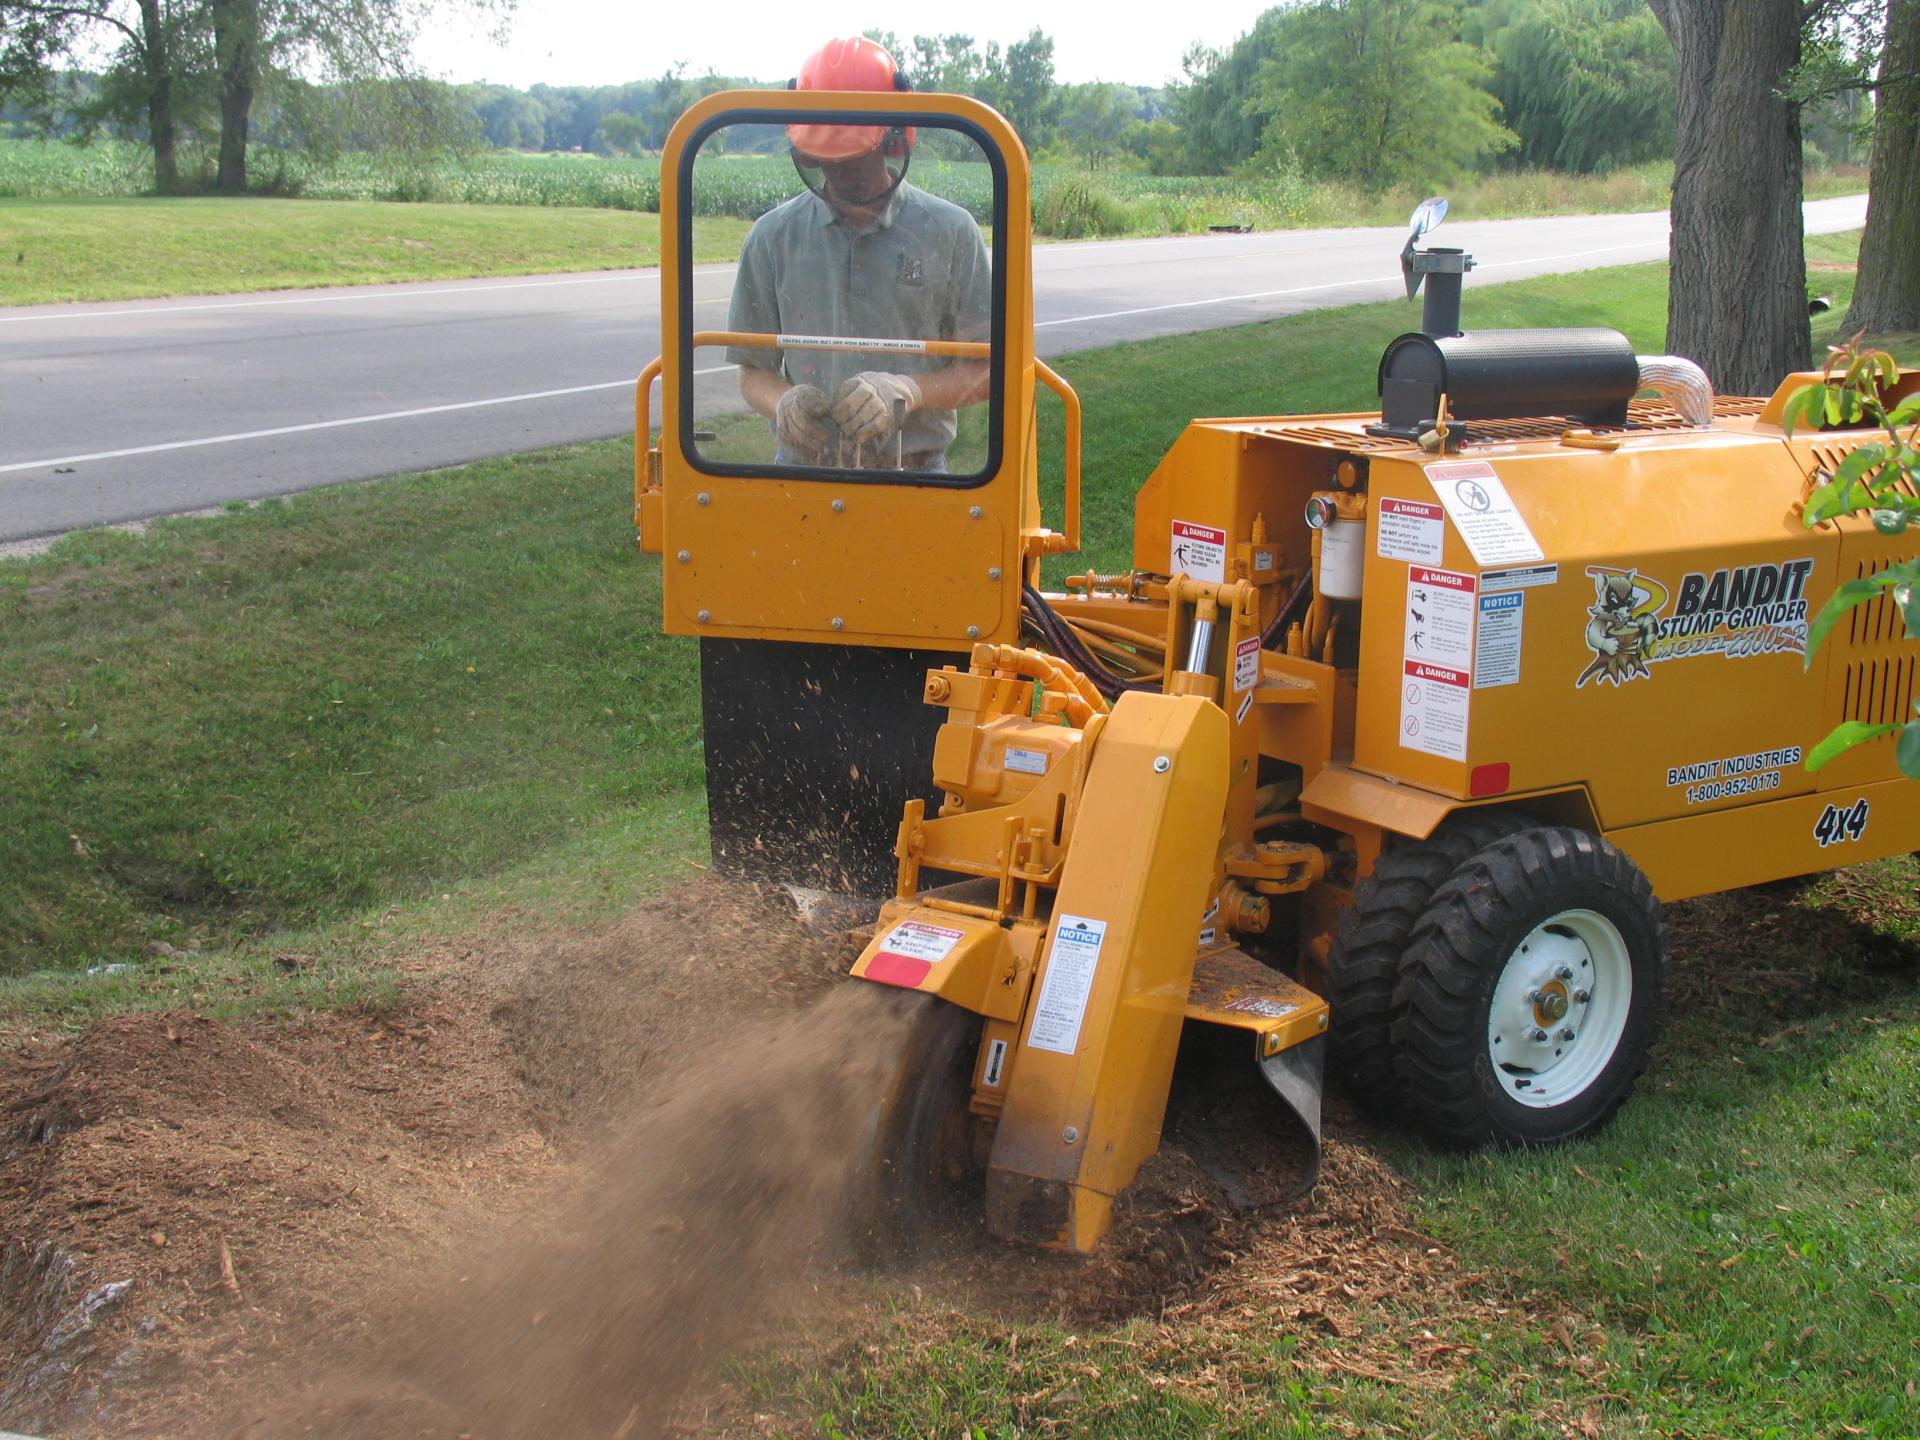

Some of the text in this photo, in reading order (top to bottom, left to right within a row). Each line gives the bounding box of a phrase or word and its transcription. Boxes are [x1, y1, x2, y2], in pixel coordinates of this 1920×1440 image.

[1401, 504, 1430, 515] DANGER
[1189, 527, 1215, 540] DANGER
[1430, 573, 1463, 586] DANGER
[1675, 560, 1813, 617] BANDIT
[1483, 595, 1518, 609] NOTICE
[1656, 600, 1807, 641] STUMP GRINDER
[1654, 634, 1728, 659] MODEL
[1425, 667, 1457, 681] DANGER
[1668, 747, 1801, 785] BANDIT INDUSTRIES
[1687, 772, 1780, 803] 1-800-952-0178
[1815, 799, 1868, 846] 4x4
[918, 926, 960, 938] DANGER
[1059, 928, 1099, 944] NOTICE
